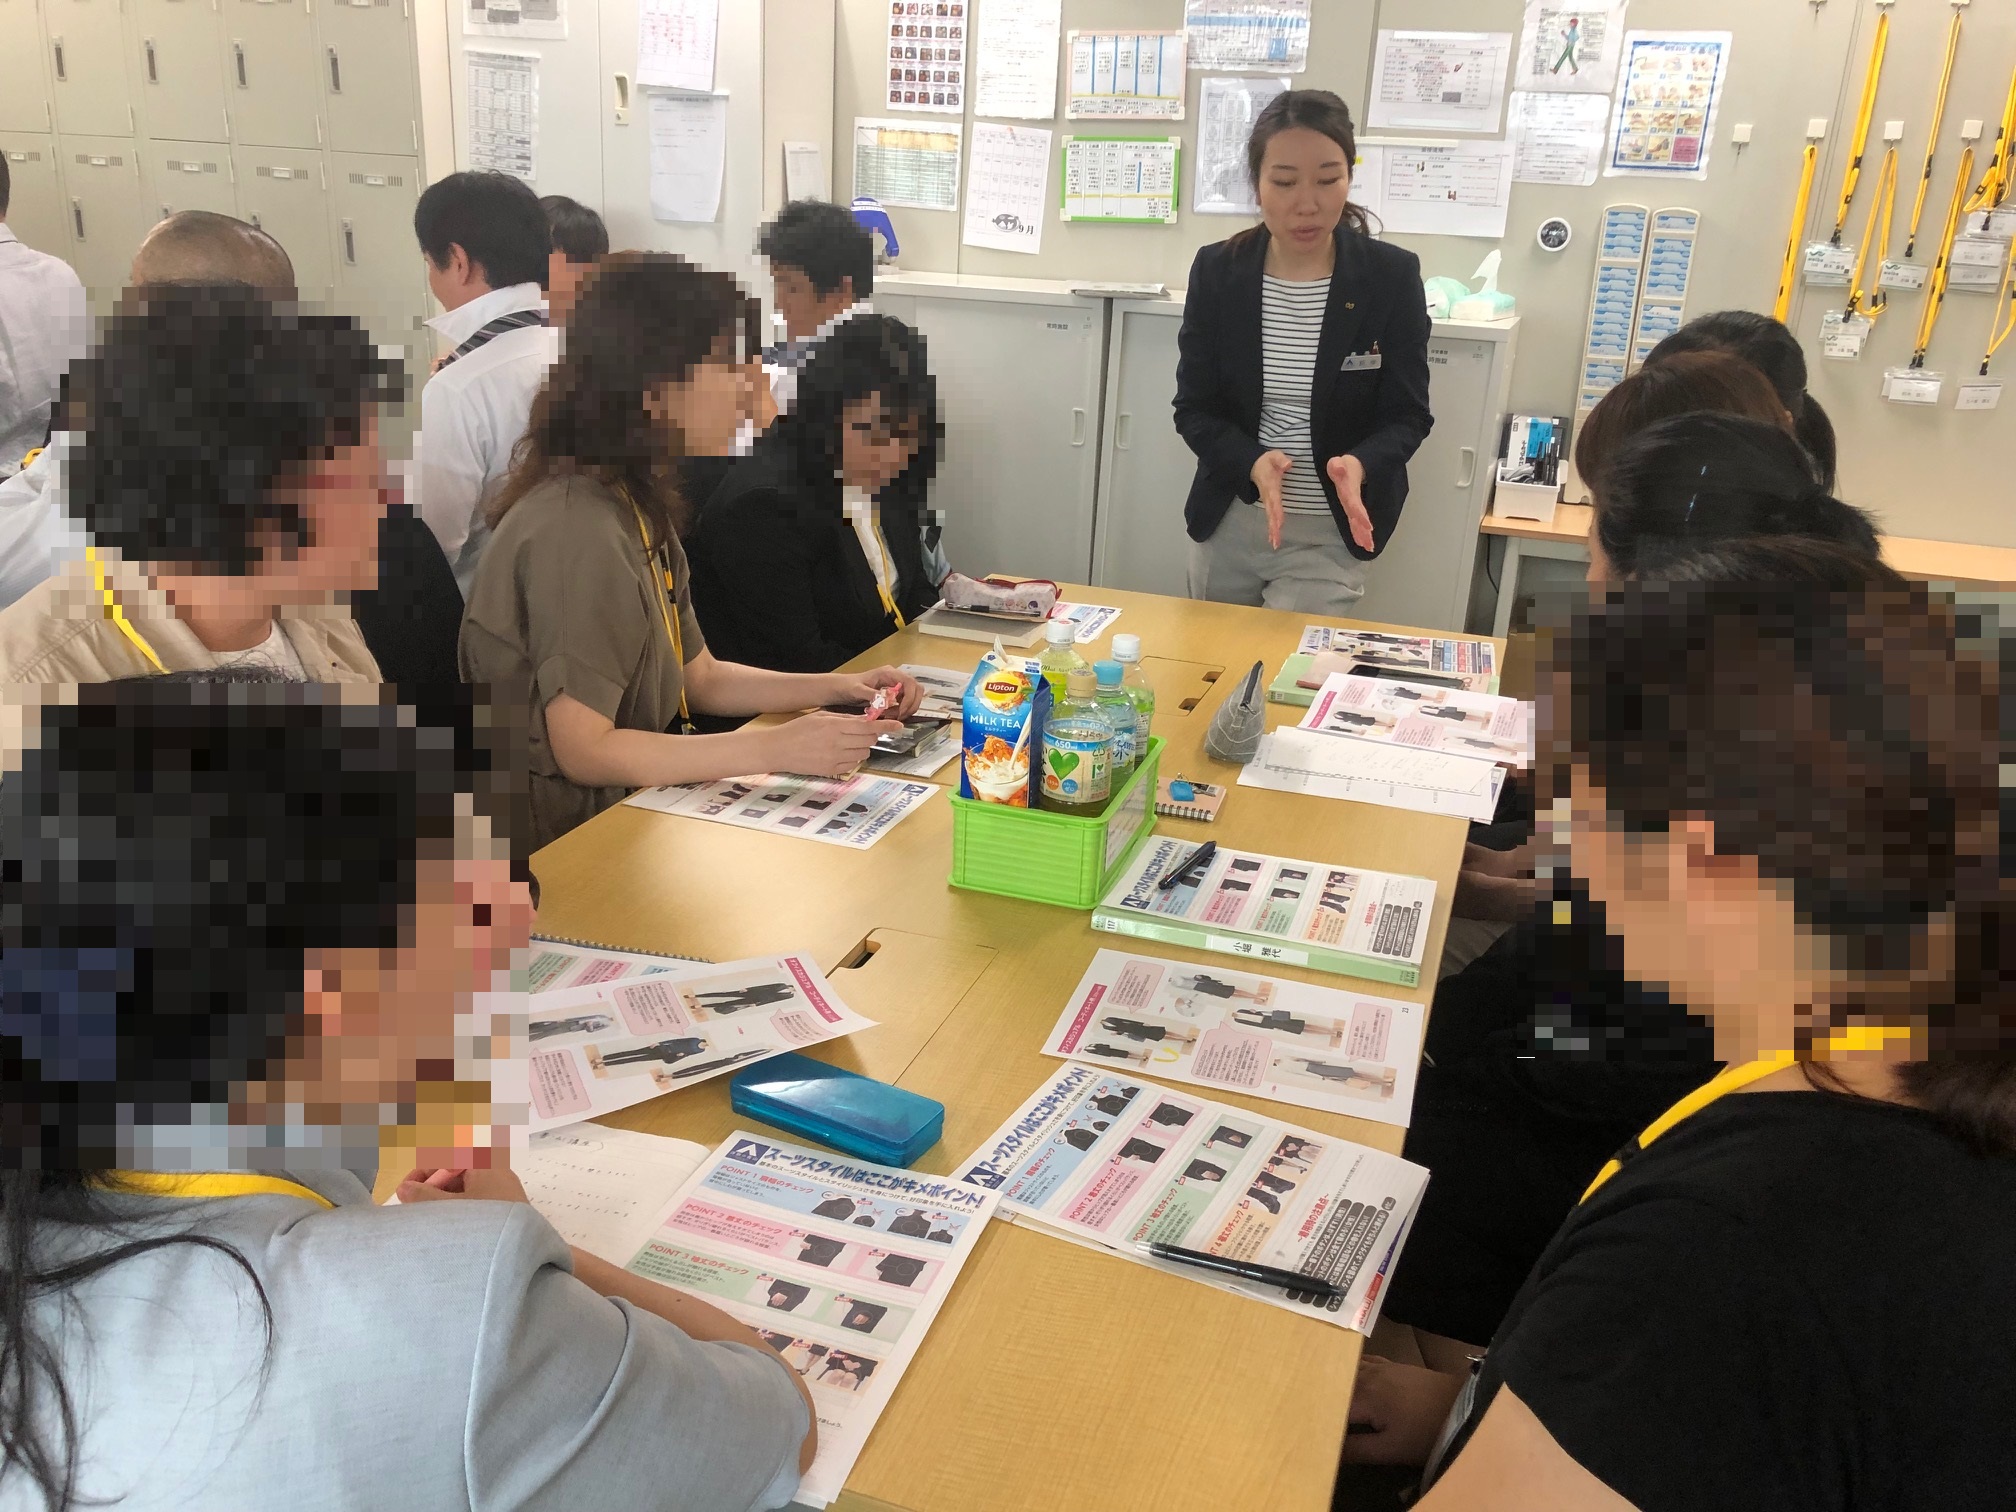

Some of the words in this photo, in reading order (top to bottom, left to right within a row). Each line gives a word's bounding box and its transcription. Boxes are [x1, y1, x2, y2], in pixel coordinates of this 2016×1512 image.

[988, 683, 1015, 692] Lipton
[970, 713, 997, 726] MILK
[1001, 718, 1021, 729] TEA
[1233, 941, 1252, 954] 小堀
[1260, 946, 1282, 959] 雅代
[977, 1066, 1092, 1172] スーツスタイルはここがキメポイント!
[719, 1165, 750, 1176] POINT
[758, 1175, 814, 1193] 肩幅のチェック
[758, 1160, 975, 1214] 基本のスーツスタイルとスタイリッシュさを身につけて、好印象を手に入れよう!
[762, 1147, 986, 1208] スーツスタイルはここがキメポイント!
[1005, 1180, 1025, 1197] POINT
[1068, 1201, 1088, 1219] POINT
[1087, 1167, 1118, 1197] 着丈のチェック
[684, 1203, 716, 1215] POINT
[725, 1215, 782, 1234] 着丈のチェック
[1132, 1223, 1151, 1241] POINT
[1149, 1187, 1179, 1219] 袖丈のチェック
[648, 1243, 681, 1256] POINT
[689, 1255, 749, 1275] 袖丈のチェック
